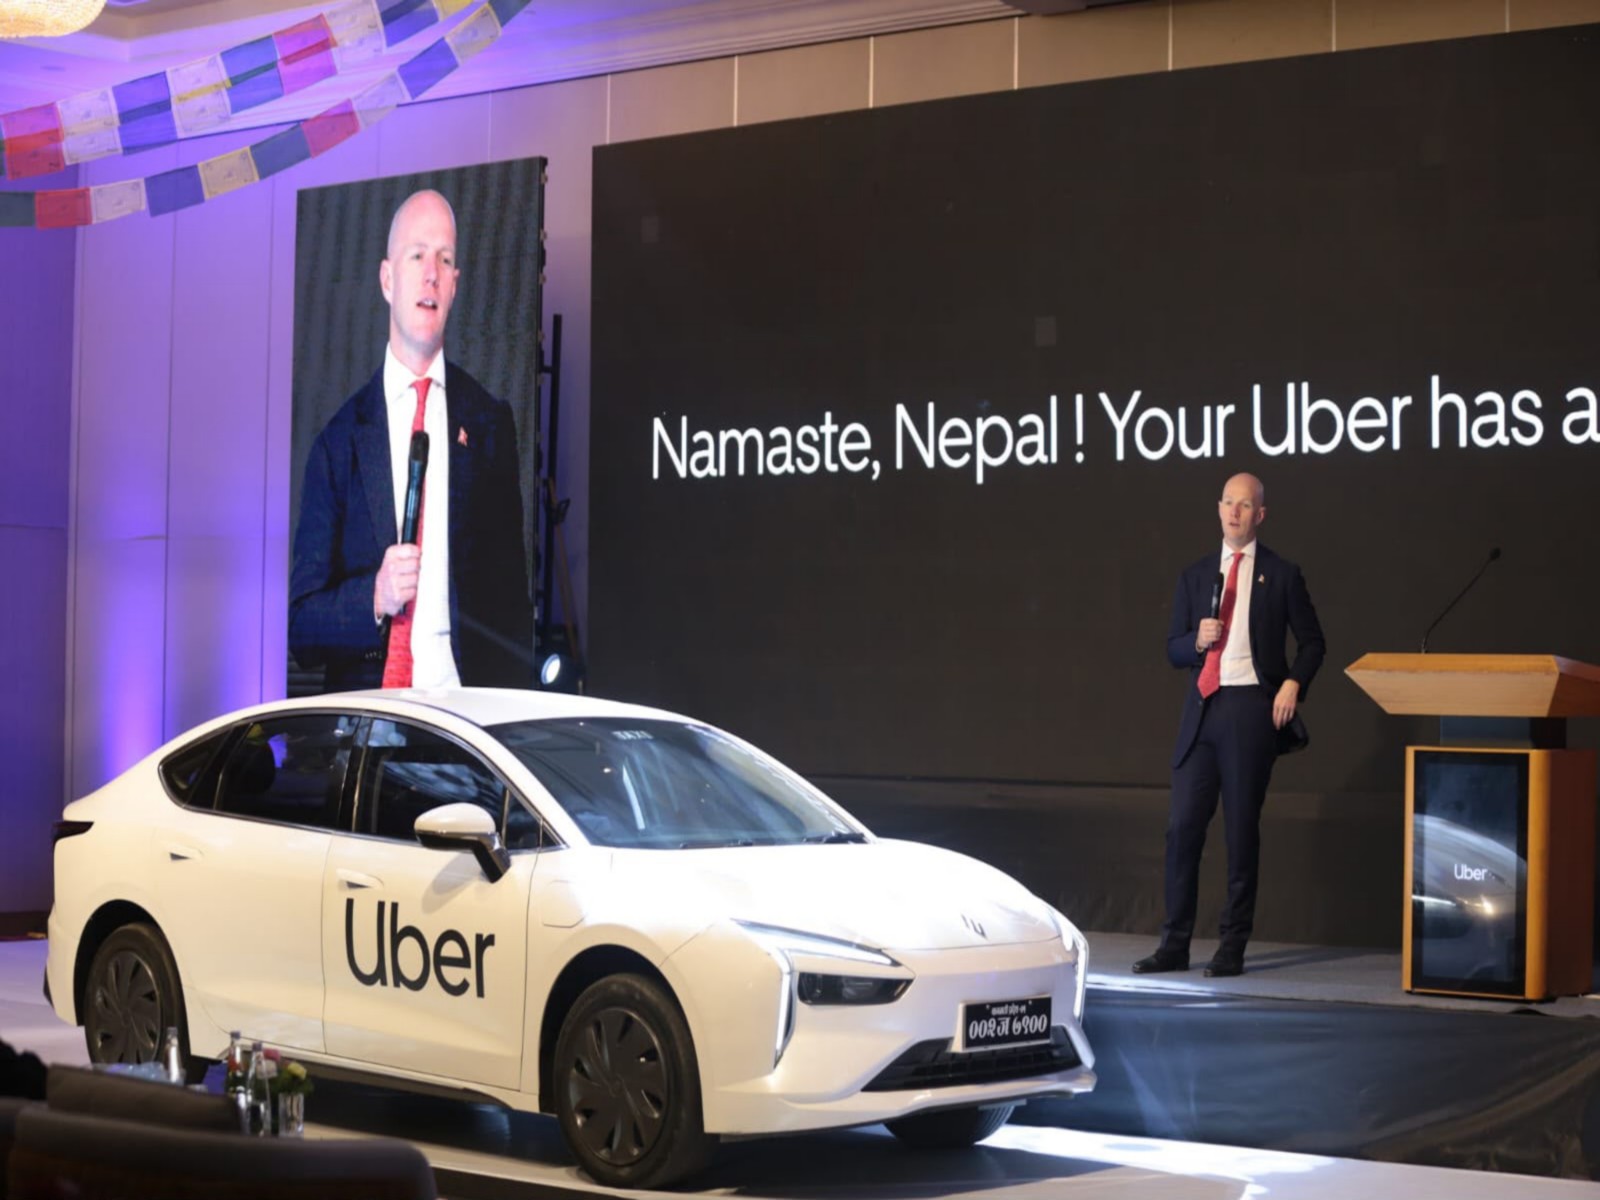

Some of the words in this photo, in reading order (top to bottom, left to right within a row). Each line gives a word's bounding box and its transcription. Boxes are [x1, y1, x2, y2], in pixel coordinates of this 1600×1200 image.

[652, 410, 881, 481] Namaste,
[1098, 389, 1236, 463] Your
[1252, 381, 1413, 457] Uber
[1430, 374, 1545, 449] has
[1454, 863, 1488, 881] Uber
[345, 898, 495, 999] Uber
